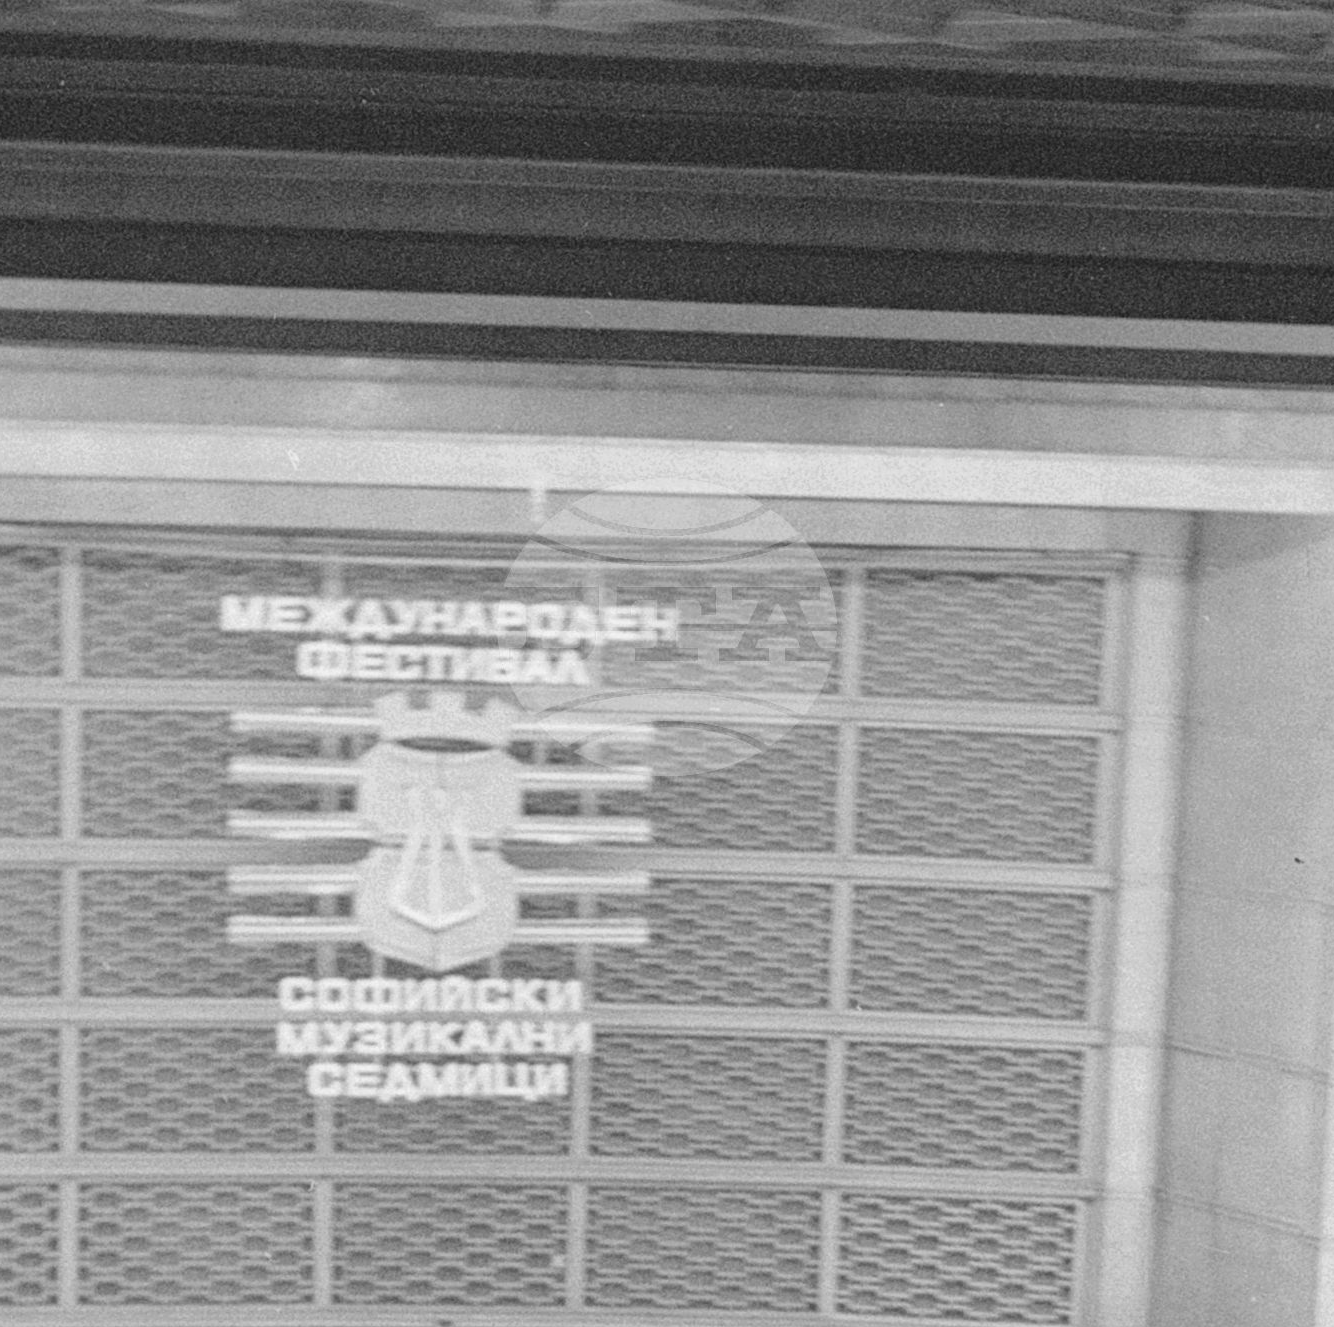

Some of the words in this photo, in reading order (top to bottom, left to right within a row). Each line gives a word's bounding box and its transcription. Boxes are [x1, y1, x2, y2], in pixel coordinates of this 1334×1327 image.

[219, 594, 681, 644] МЕЖДУНАРОДЕН
[296, 641, 591, 685] ФЕСТИВАЛ
[277, 975, 584, 1013] СОФИЙСКИ
[276, 1020, 595, 1055] МУЗИКАЛНИ
[306, 1062, 570, 1102] СЕДМИЦИ
